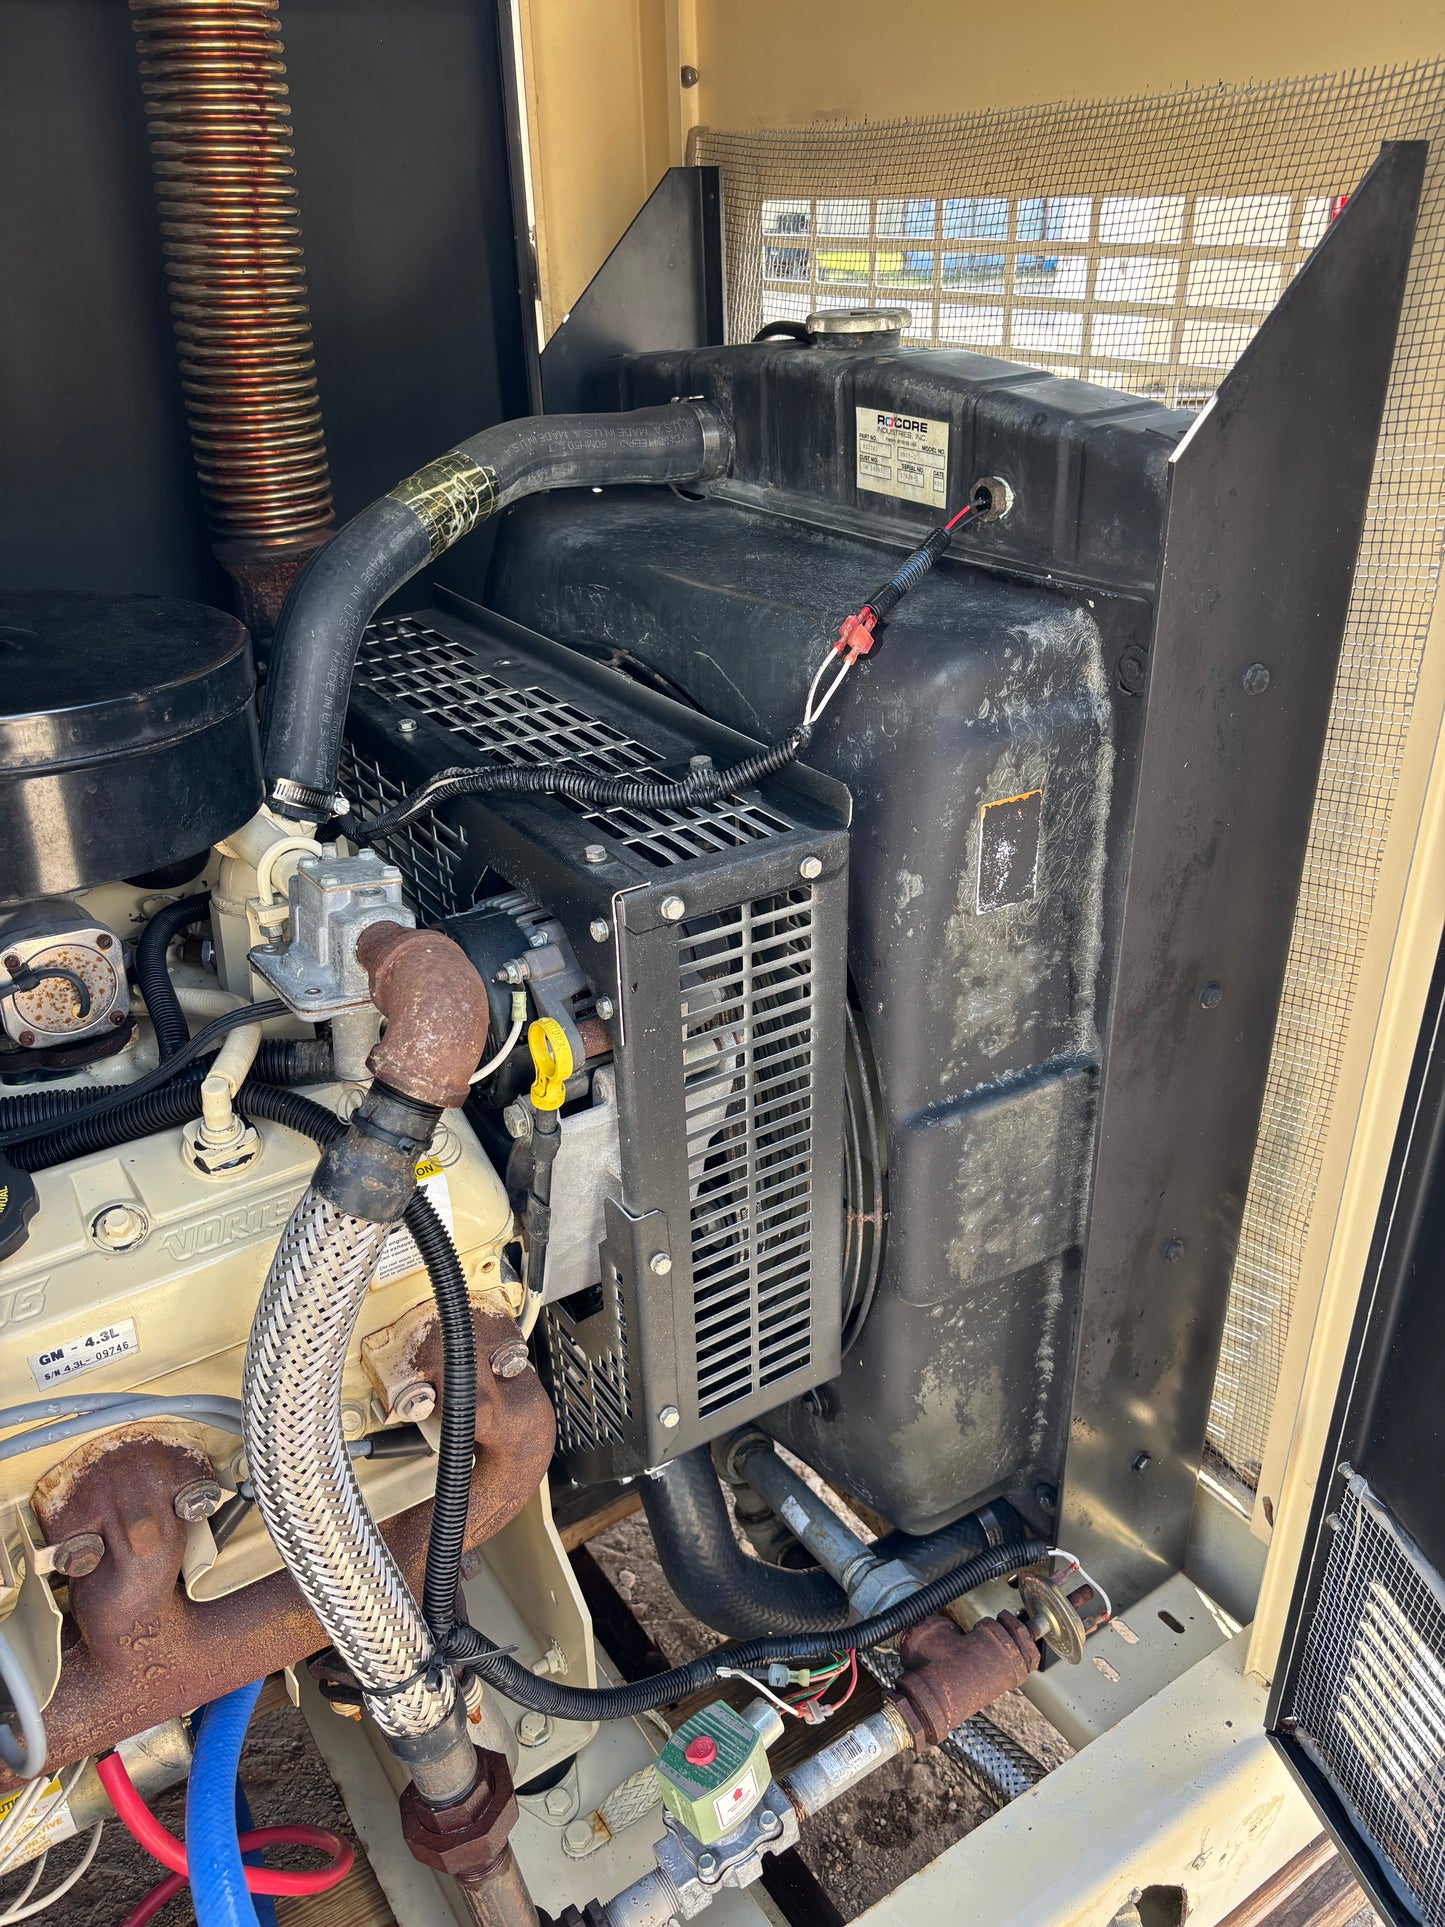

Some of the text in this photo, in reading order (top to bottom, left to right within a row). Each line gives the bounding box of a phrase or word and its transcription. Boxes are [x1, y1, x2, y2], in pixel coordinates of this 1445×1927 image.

[877, 414, 928, 433] ROCORE
[39, 1349, 64, 1366] GM
[85, 1328, 119, 1348] 4.3L
[44, 1369, 61, 1381] S/N
[95, 1341, 129, 1361] 09746
[663, 1855, 677, 1871] OUT
